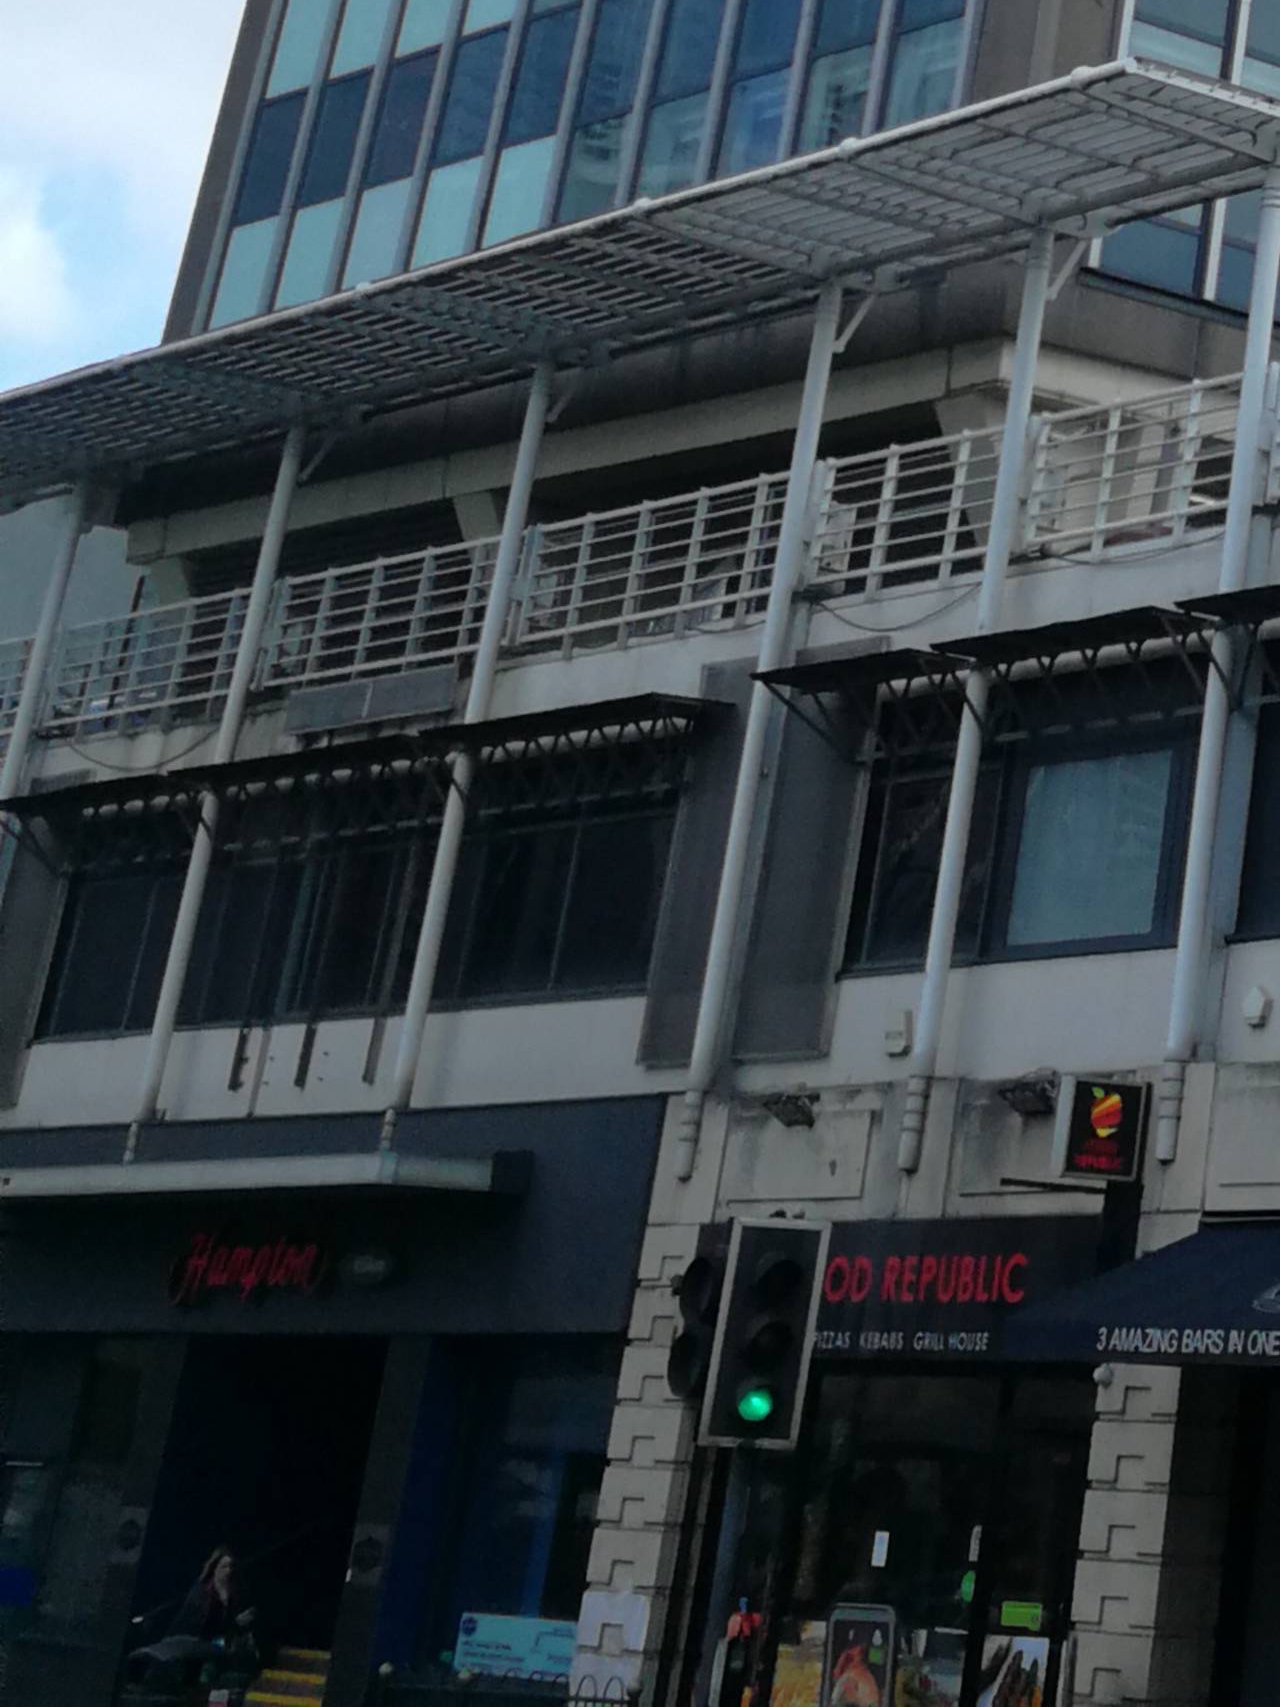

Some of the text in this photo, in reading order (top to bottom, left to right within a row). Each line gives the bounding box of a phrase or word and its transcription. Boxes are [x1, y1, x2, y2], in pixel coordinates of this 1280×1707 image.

[823, 1250, 1029, 1305] OD REPUBLIC
[859, 1331, 905, 1351] KEBABS
[913, 1332, 944, 1351] GRILL
[948, 1331, 990, 1352] HOUSE
[1096, 1325, 1107, 1353] 3
[1108, 1326, 1179, 1355] AMAZING
[1181, 1327, 1225, 1355] BARS
[1227, 1328, 1246, 1356] IN
